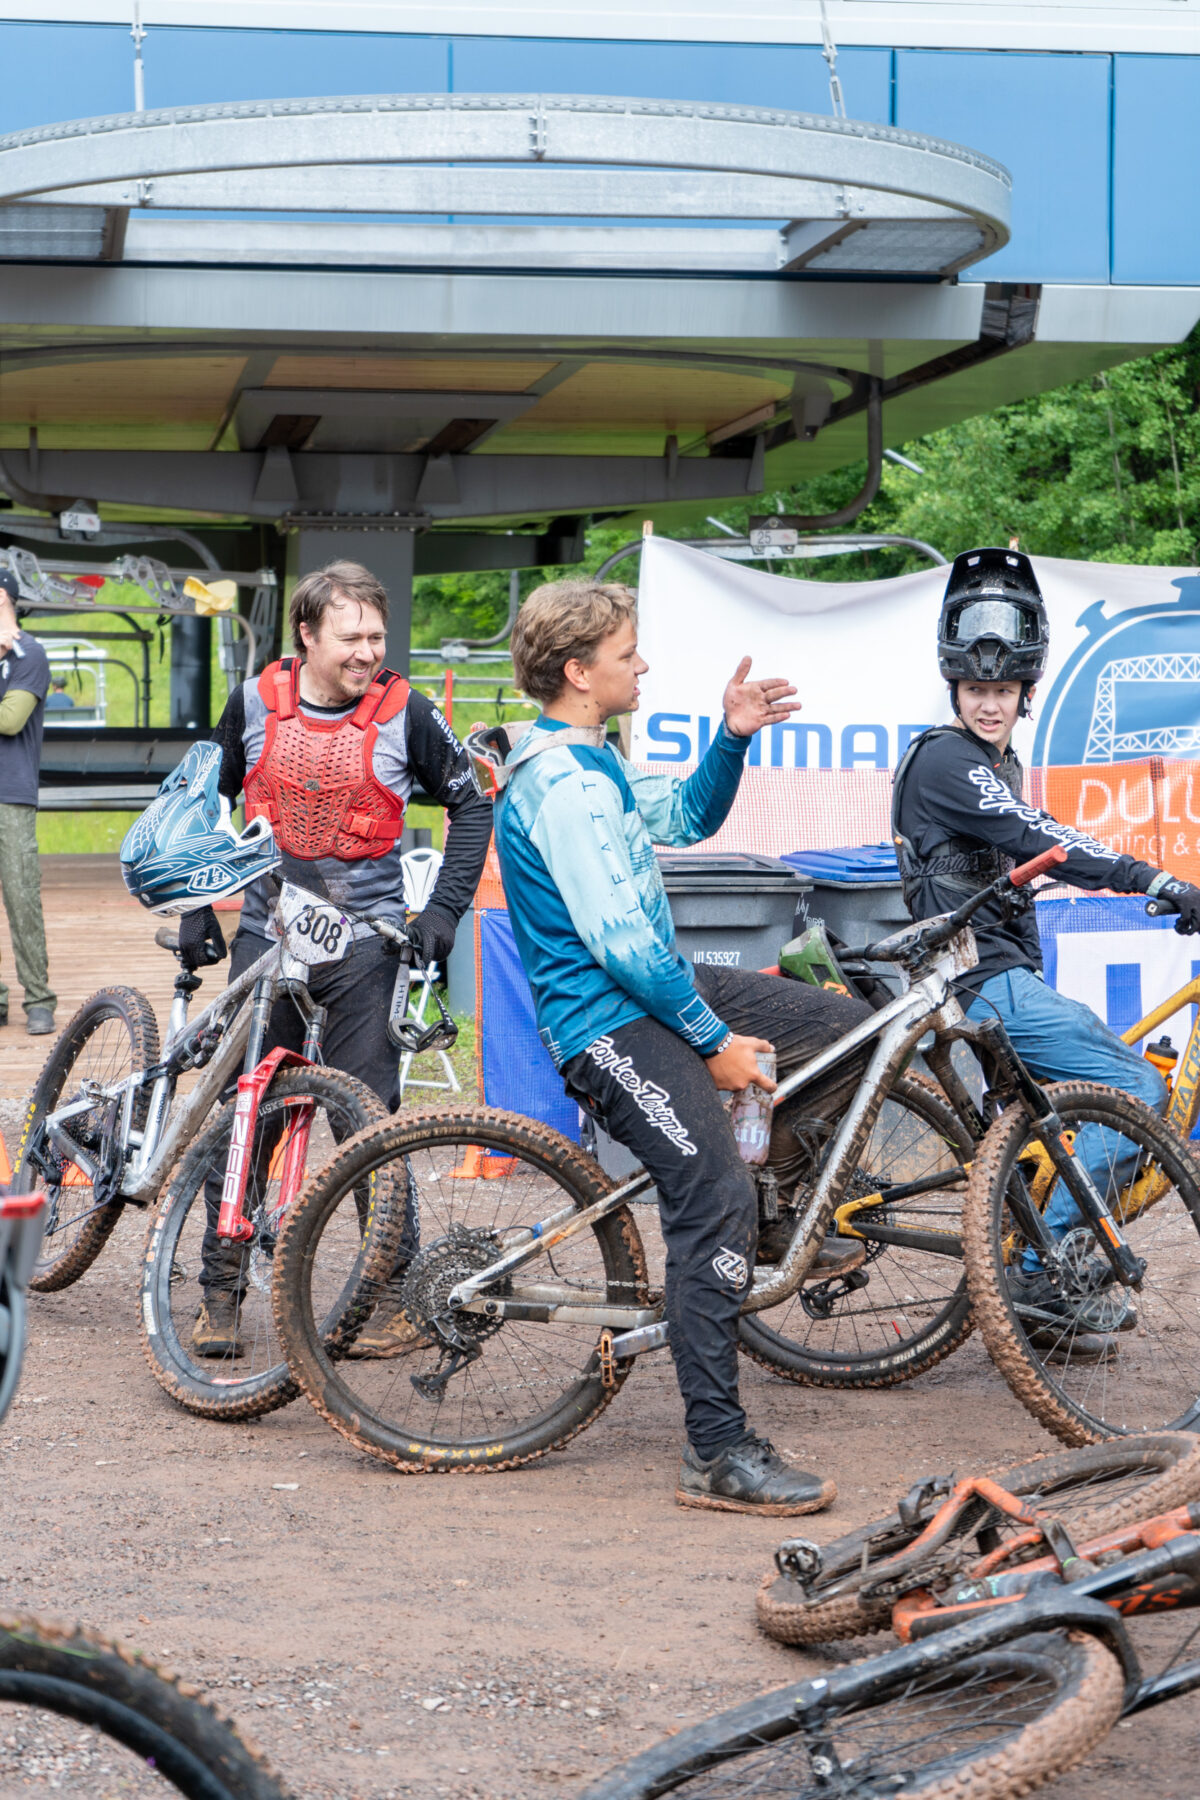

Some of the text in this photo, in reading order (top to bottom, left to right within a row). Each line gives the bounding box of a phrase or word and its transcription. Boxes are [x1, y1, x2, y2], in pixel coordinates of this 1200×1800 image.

[68, 513, 79, 528] 24
[757, 530, 771, 545] 25
[1172, 832, 1190, 856] &
[296, 904, 342, 954] 308
[804, 1062, 897, 1247] TRANSITION
